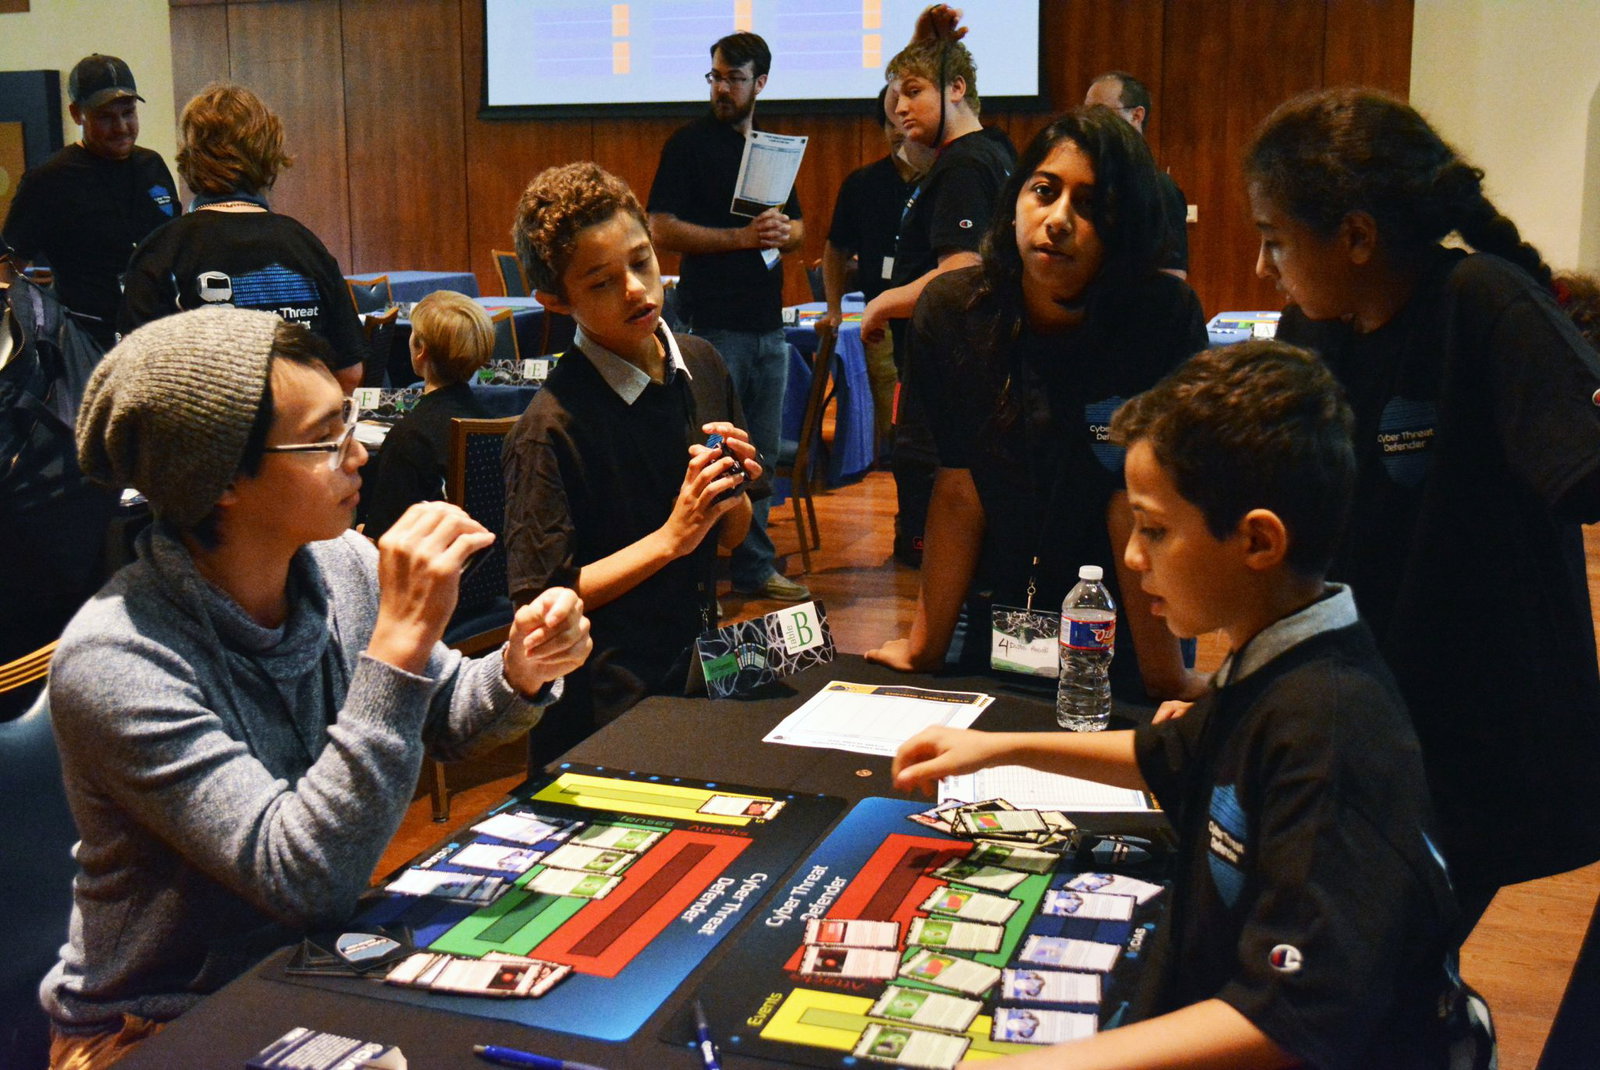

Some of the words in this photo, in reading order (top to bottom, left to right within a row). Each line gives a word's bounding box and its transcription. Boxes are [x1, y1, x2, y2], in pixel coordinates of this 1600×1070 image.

[280, 306, 319, 319] Threat
[532, 364, 542, 378] E
[362, 391, 372, 407] F
[1377, 434, 1400, 444] Cyber
[1401, 428, 1434, 440] Threat
[1384, 441, 1425, 452] Defender
[785, 625, 799, 650] Table
[791, 611, 813, 647] B
[688, 824, 750, 837] Attacks
[681, 877, 735, 923] Defender
[733, 872, 768, 902] Cyber
[765, 896, 801, 927] Cyber
[791, 865, 829, 897] Threat
[800, 875, 847, 921] Defender
[698, 902, 742, 935] Threat
[746, 992, 782, 1026] Events
